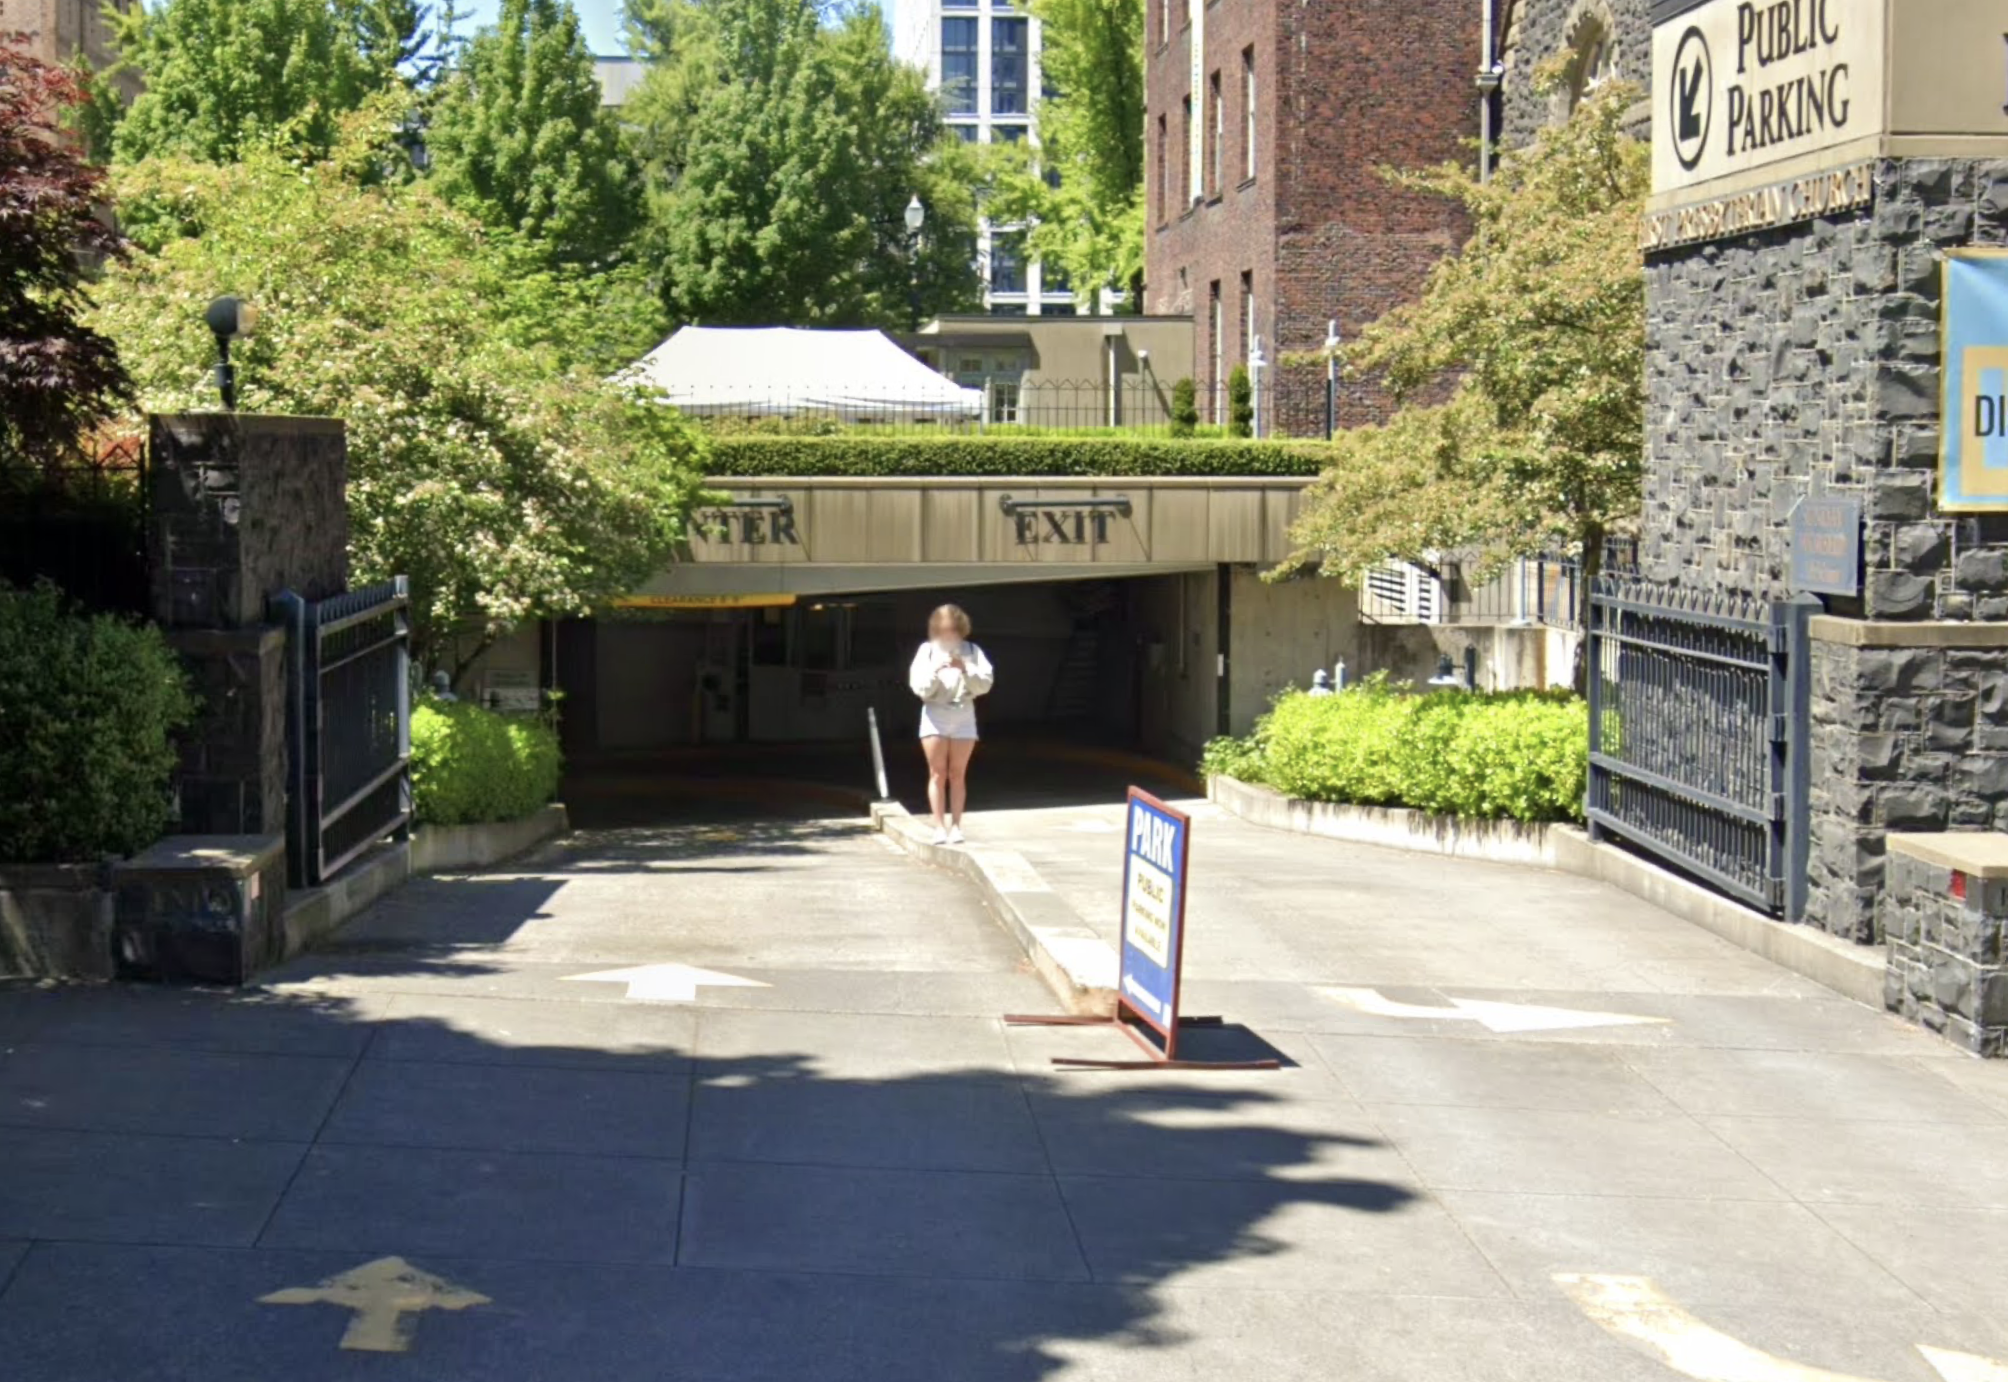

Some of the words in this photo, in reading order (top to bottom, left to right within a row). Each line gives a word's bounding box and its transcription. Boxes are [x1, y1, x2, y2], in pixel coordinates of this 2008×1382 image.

[1737, 0, 1839, 74] PUBLIC
[1727, 63, 1850, 157] PARKING
[1790, 163, 1873, 220] CHURCH
[1974, 394, 2008, 438] DI
[687, 509, 799, 544] NTER
[1014, 510, 1117, 545] EXIT
[1131, 804, 1177, 874] PARK
[1137, 872, 1165, 904] PUBLIC
